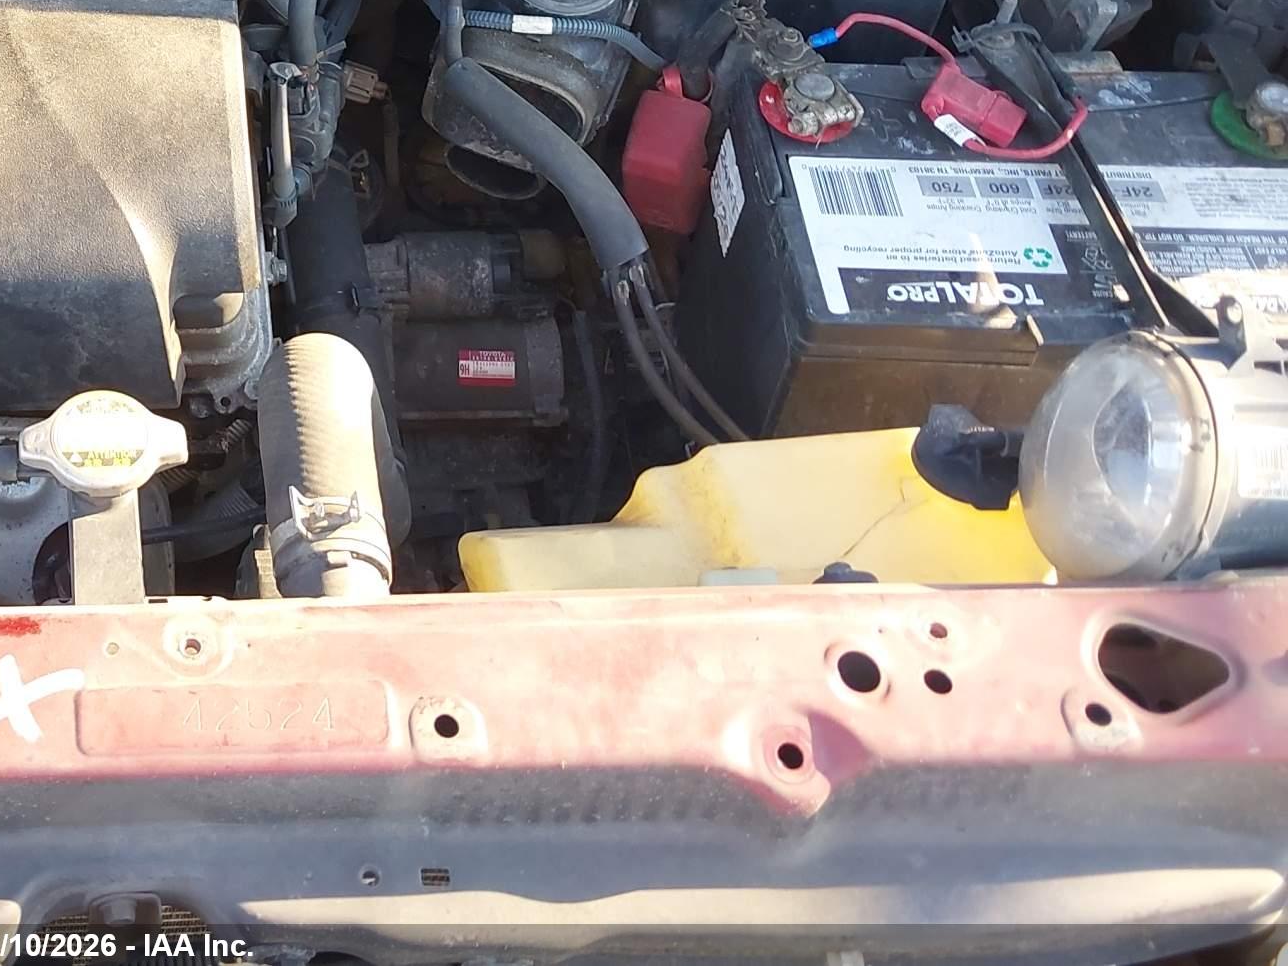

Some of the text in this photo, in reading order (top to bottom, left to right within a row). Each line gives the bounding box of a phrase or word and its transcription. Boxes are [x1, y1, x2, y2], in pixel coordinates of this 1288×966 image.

[1103, 171, 1152, 179] DISTRIBUT
[932, 181, 962, 194] 750
[989, 182, 1020, 195] 600
[1113, 186, 1153, 198] 24F-
[843, 245, 887, 254] recycling
[890, 245, 923, 254] proper
[926, 248, 939, 256] for
[941, 247, 966, 256] store
[886, 254, 898, 262] an
[900, 254, 910, 263] to
[912, 255, 957, 265] batteries
[887, 281, 1044, 306] TOTALPRO
[459, 363, 470, 376] 9H
